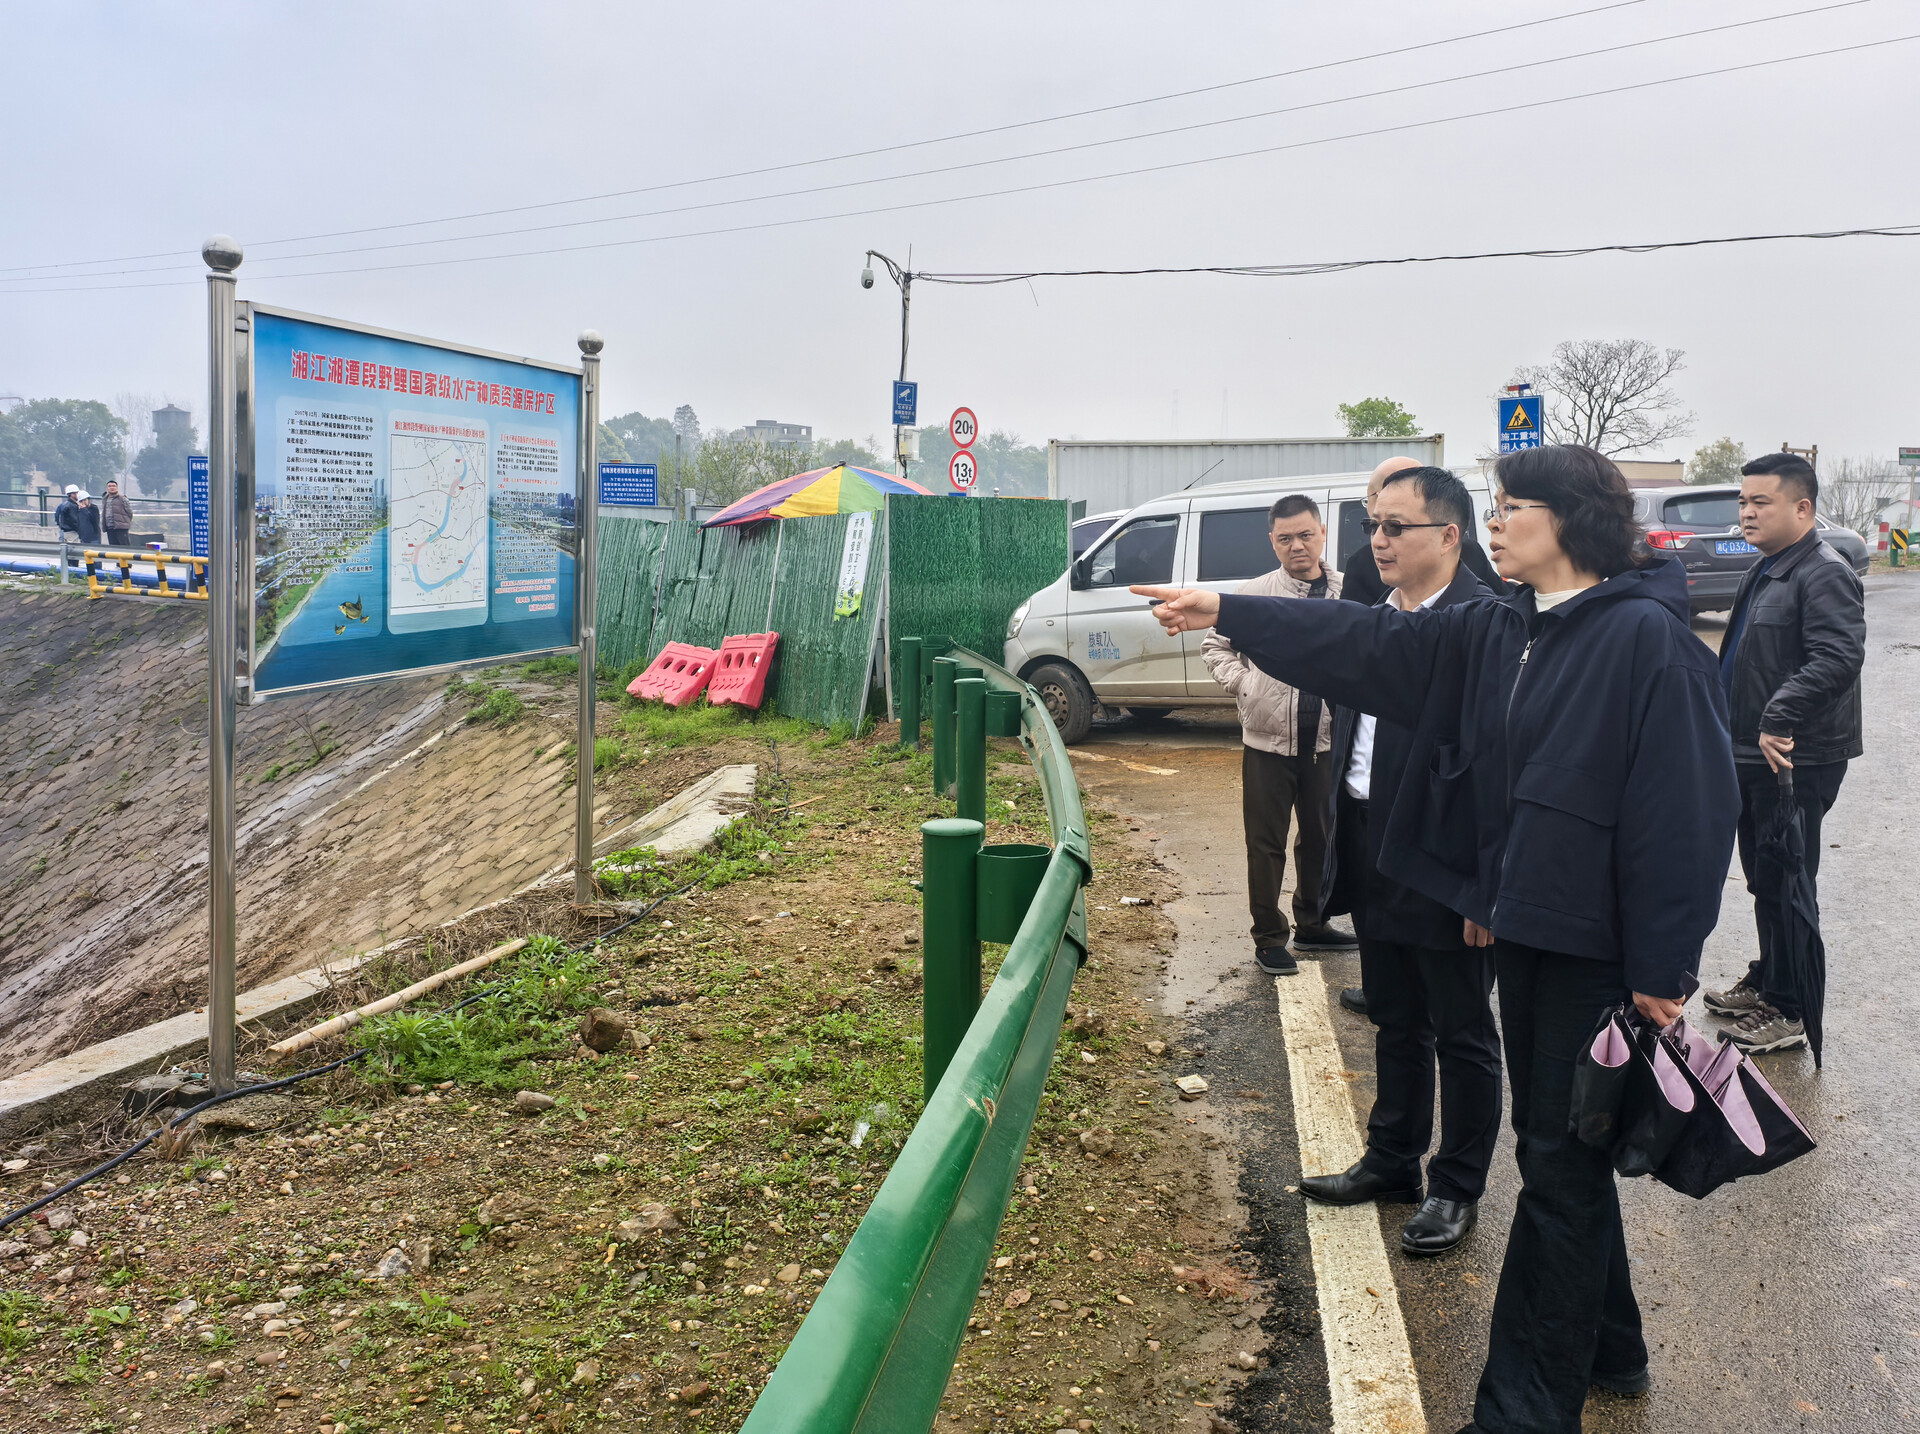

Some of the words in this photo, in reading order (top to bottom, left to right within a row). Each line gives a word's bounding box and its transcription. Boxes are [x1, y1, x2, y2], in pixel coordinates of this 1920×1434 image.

[291, 348, 556, 415] 湘江湘潭段野鲤国家级水产种质资源保护区
[954, 420, 974, 435] 20t
[1501, 431, 1538, 441] 施工重地
[1502, 442, 1538, 452] 闲人免入
[954, 463, 972, 478] 13t
